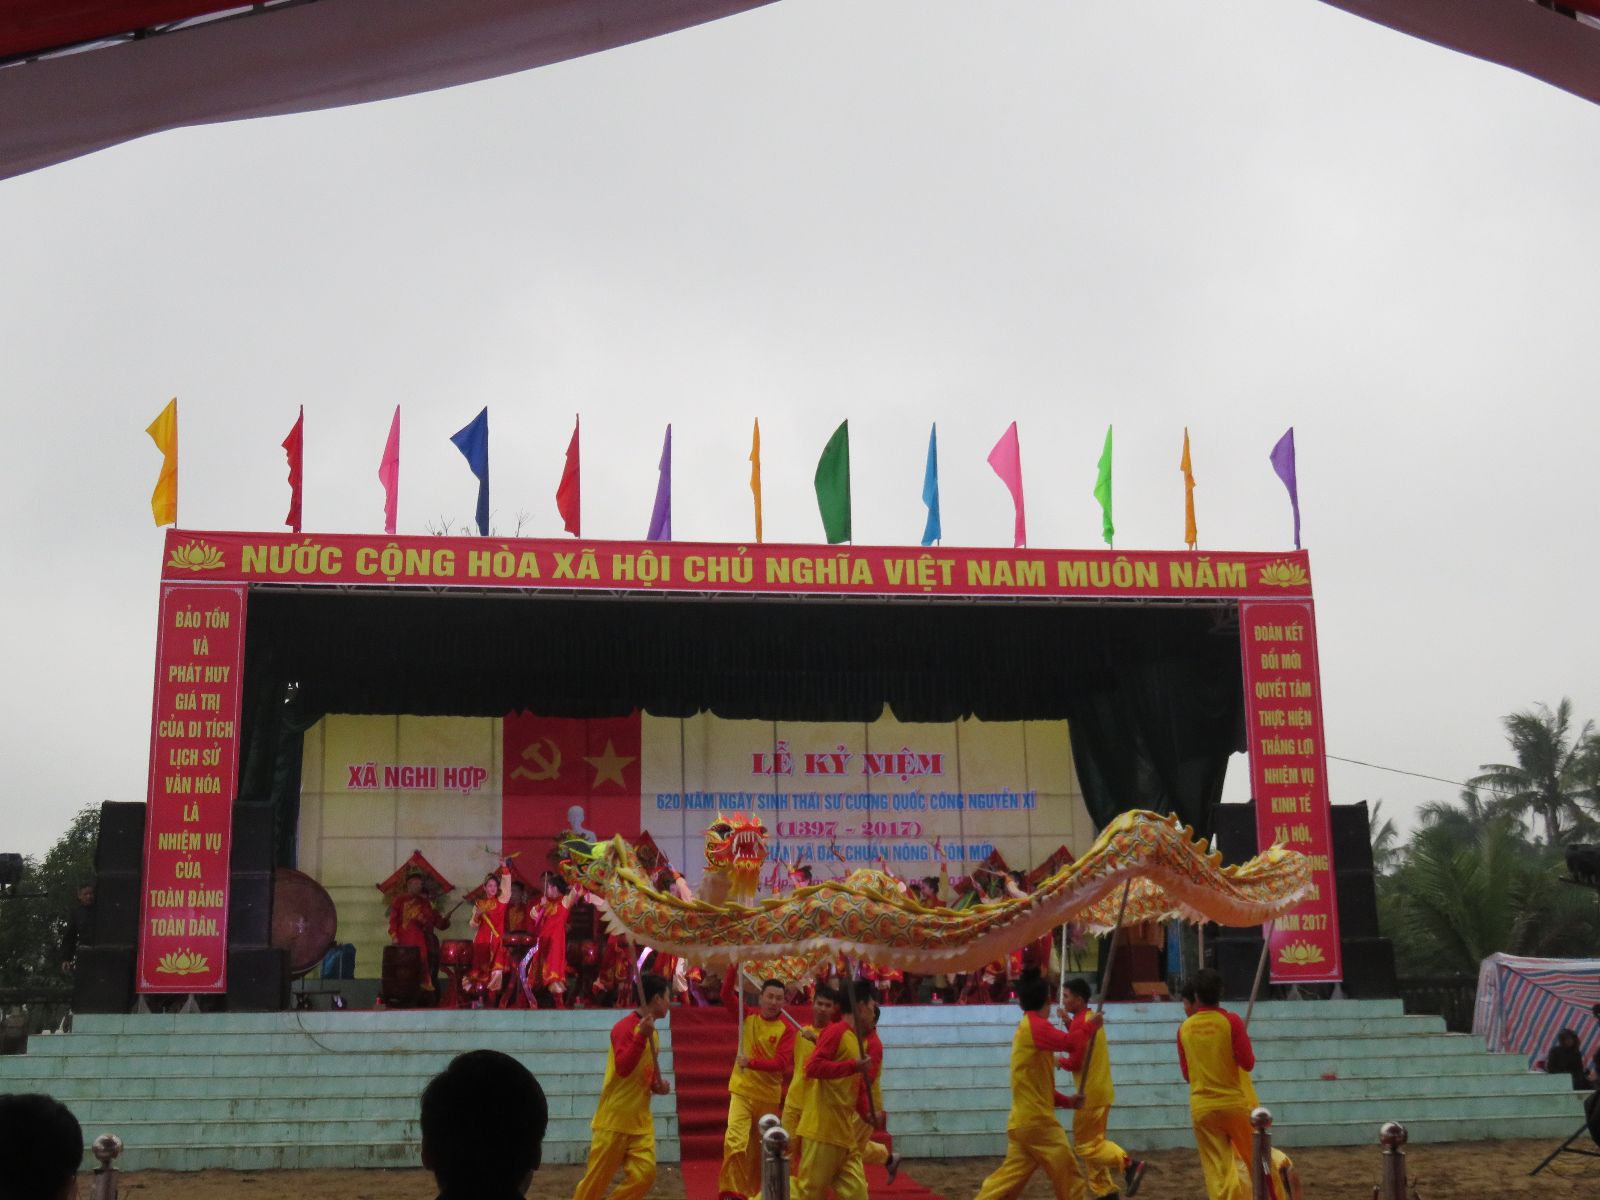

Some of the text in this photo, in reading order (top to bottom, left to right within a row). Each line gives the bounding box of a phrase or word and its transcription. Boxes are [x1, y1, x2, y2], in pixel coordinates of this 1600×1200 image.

[241, 539, 1247, 591] NƯỚC CỘNG HÒA XÃ HỘI CHỦ NGHĨA VIỆT NAM MUÔN NĂM
[175, 604, 201, 628] BẢO
[1285, 620, 1304, 641] KẾT
[192, 635, 209, 655] VÀ
[168, 662, 230, 683] PHÁT HUY
[1255, 677, 1312, 699] QUYẾT TÂM
[175, 689, 221, 714] GIÁ TRỊ
[159, 714, 233, 738] CỦA DI TÍCH
[1259, 708, 1312, 729] THỰC HIỆN
[169, 742, 222, 769] LỊCH SỬ
[1297, 738, 1314, 759] LỢI
[752, 741, 944, 781] LỄ KỶ NIỆM
[165, 773, 221, 794] VĂN HÓA
[348, 762, 487, 793] XÃ NGHI HỢP
[1264, 765, 1315, 788] NHIỆM VỤ
[656, 793, 680, 810] 620
[684, 791, 715, 810] NĂM
[719, 790, 753, 810] NGÀY
[757, 793, 788, 810] SINH
[792, 791, 820, 810] THÁI
[824, 792, 843, 810] SƯ
[892, 789, 926, 811] QUỐC
[929, 791, 964, 810] CÔNG
[968, 786, 1018, 810] NGUYỄN
[1271, 791, 1312, 813] KINH TẾ
[183, 801, 200, 822] LÀ
[776, 821, 838, 838] (1397
[862, 821, 923, 838] 2017)
[158, 829, 222, 855] NHIỆM VỤ
[892, 842, 928, 861] NÔNG
[175, 854, 202, 879] CỦA
[150, 883, 224, 907] TOÀN ĐẢNG
[151, 914, 220, 937] TOÀN DÂN.
[1302, 913, 1327, 930] 2017
